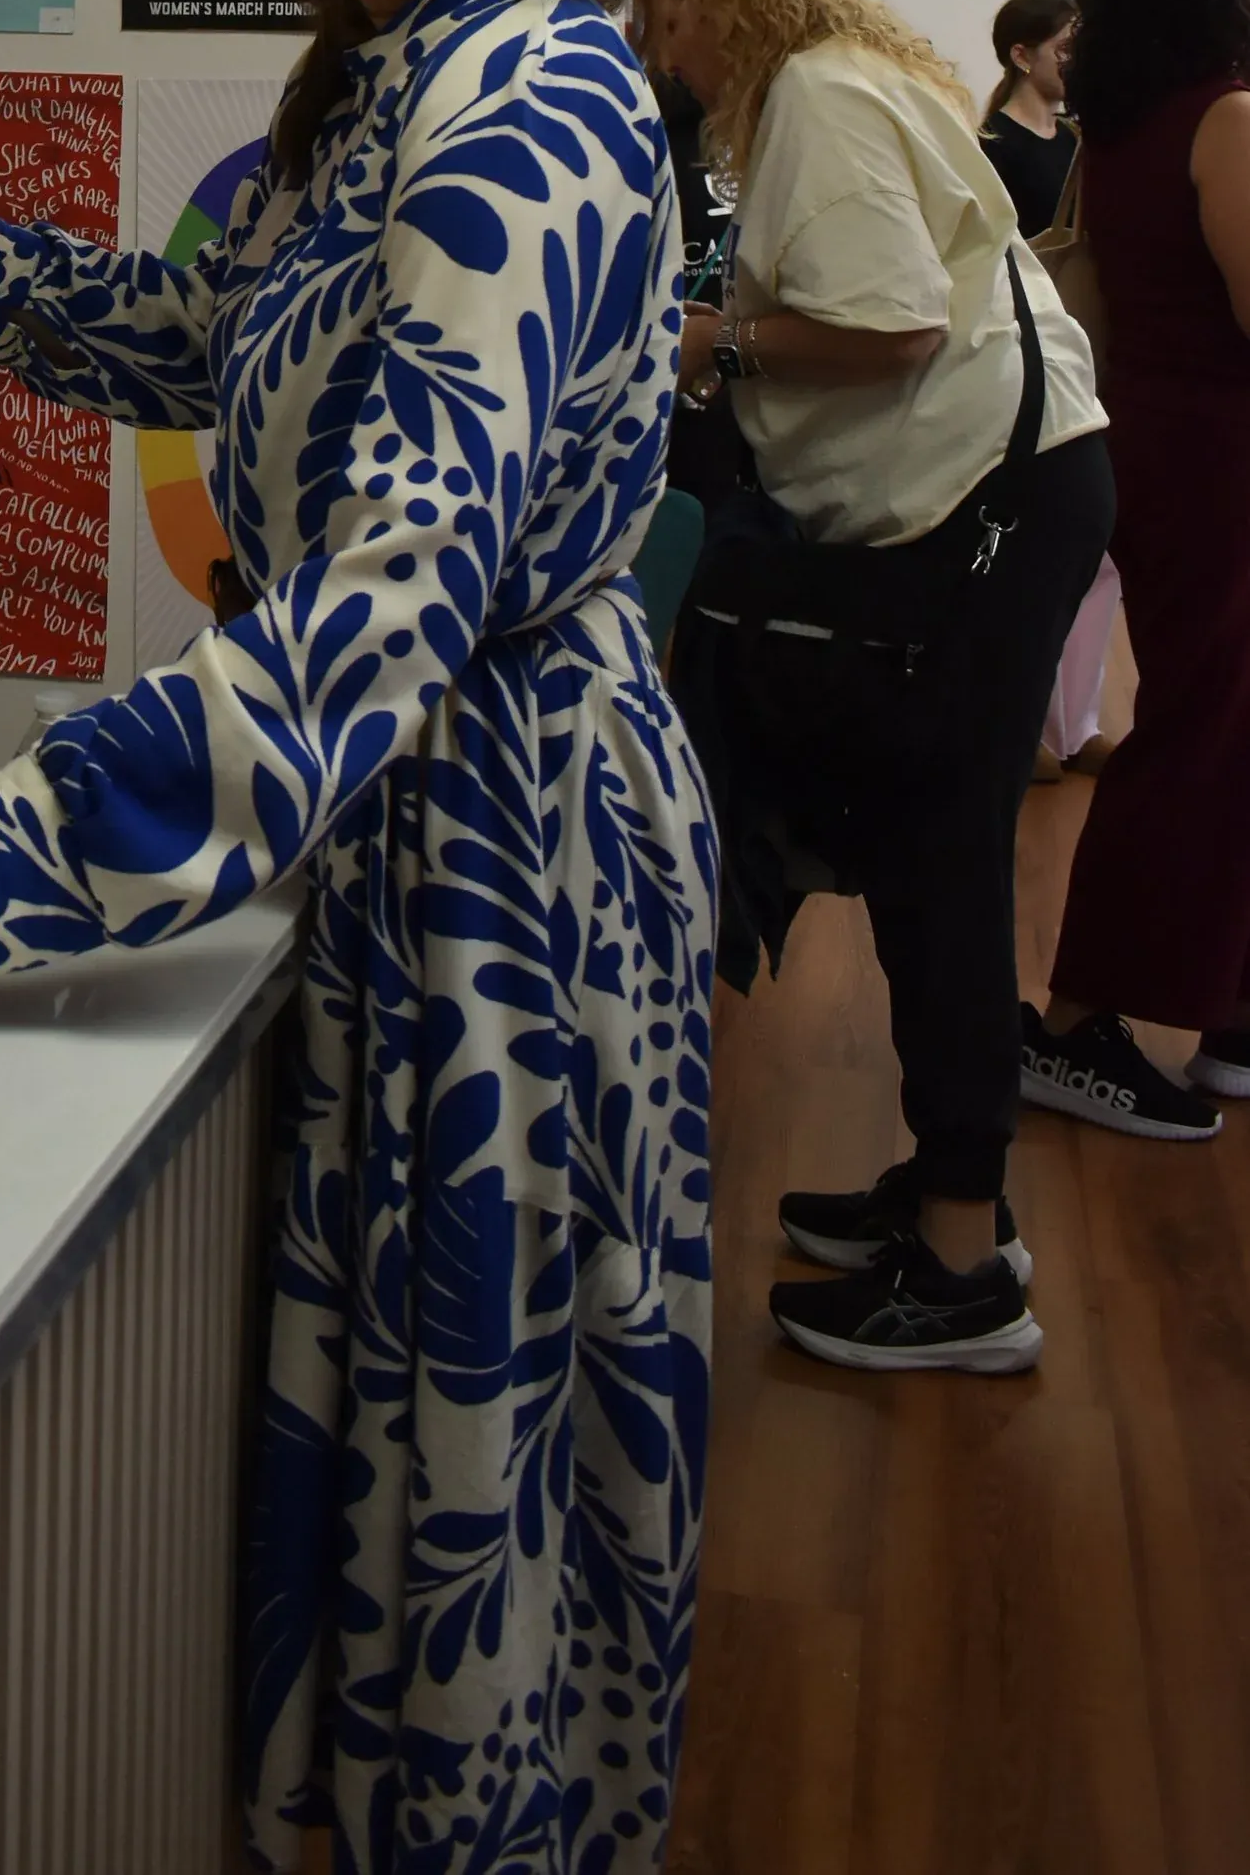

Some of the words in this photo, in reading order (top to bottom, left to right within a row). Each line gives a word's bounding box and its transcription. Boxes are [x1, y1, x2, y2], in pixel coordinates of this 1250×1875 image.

[149, 1, 212, 17] WOMEN'S
[216, 1, 263, 17] MARCH
[0, 75, 62, 93] WHAT
[50, 100, 121, 177] DAUGHTER
[6, 201, 29, 225] TO
[33, 189, 68, 221] GET
[73, 184, 119, 218] RAPED
[94, 228, 118, 247] THE
[13, 426, 56, 461] IDEA
[61, 442, 101, 465] MEN
[22, 566, 106, 618] ASKING
[43, 603, 75, 635] YOU
